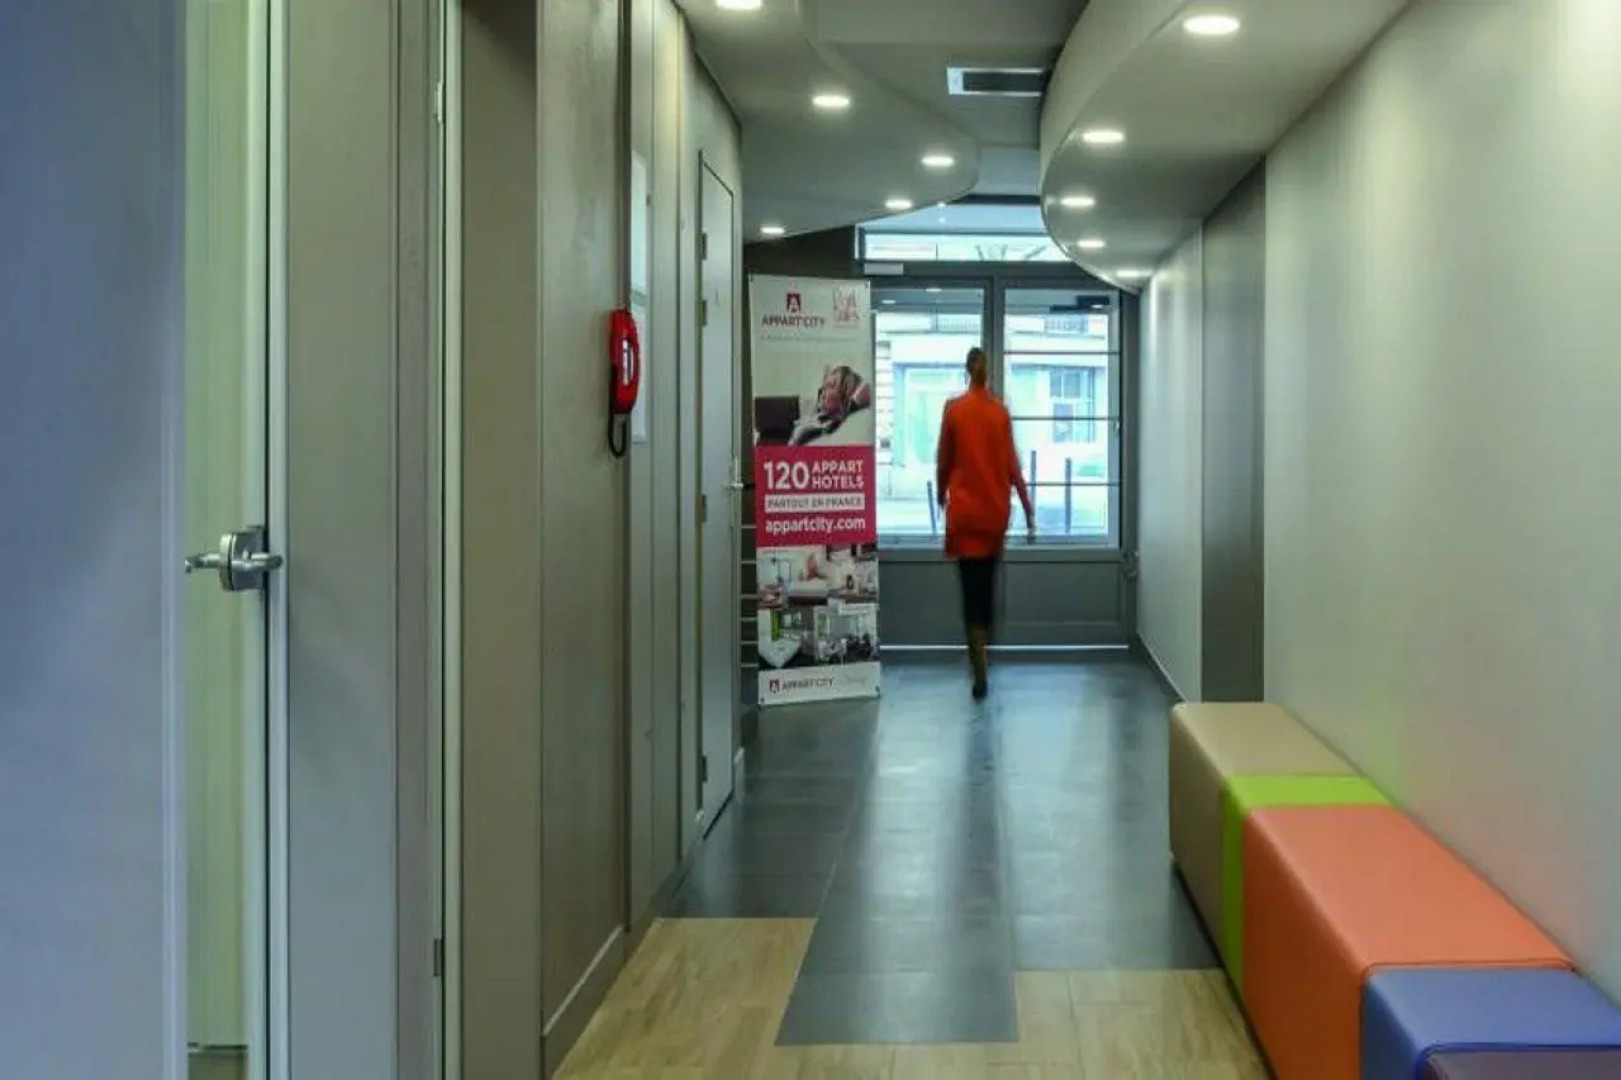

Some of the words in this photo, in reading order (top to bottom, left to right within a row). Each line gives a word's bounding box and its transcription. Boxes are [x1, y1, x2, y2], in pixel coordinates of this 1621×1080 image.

[812, 460, 863, 473] APPART
[763, 461, 809, 490] 120
[812, 475, 864, 489] HOTELS
[768, 499, 809, 508] PARTOUT
[811, 498, 825, 508] EN
[765, 517, 865, 535] appartcity.com
